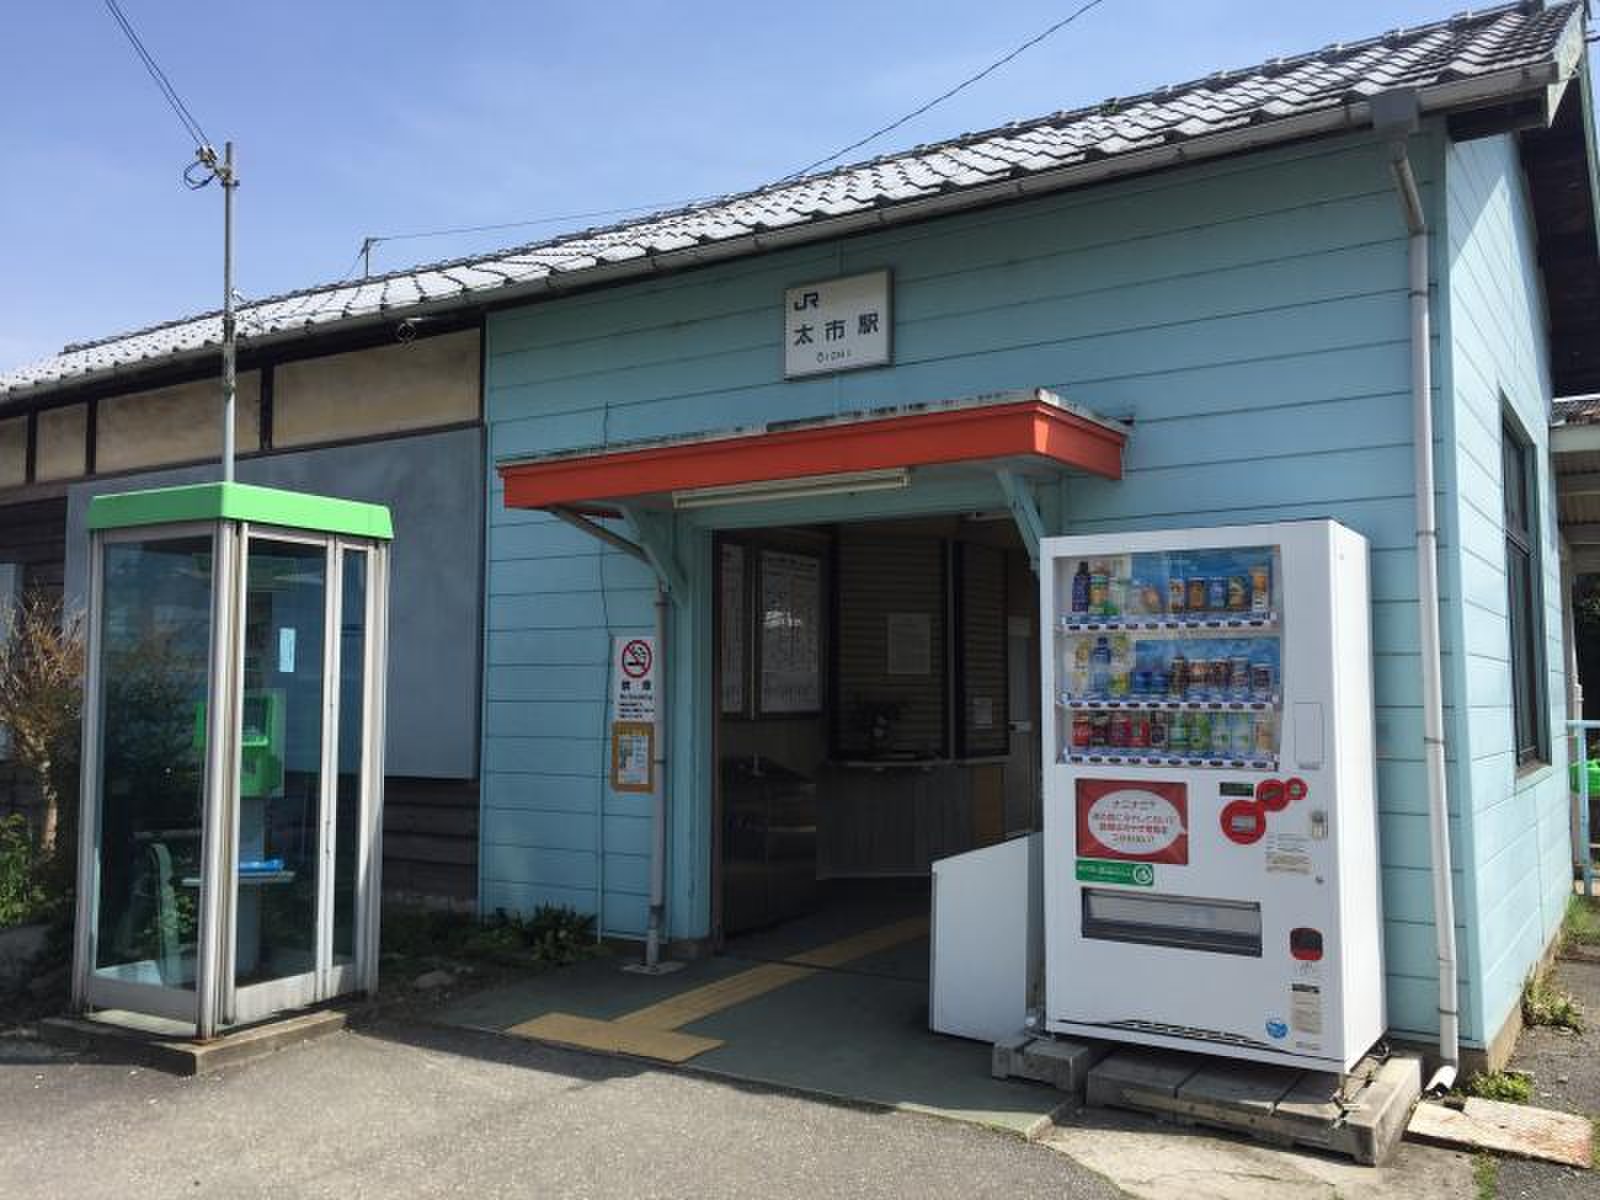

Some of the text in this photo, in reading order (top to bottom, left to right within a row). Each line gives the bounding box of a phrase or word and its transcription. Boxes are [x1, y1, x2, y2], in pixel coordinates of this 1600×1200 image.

[794, 292, 819, 311] JR
[793, 313, 880, 347] 太市駅
